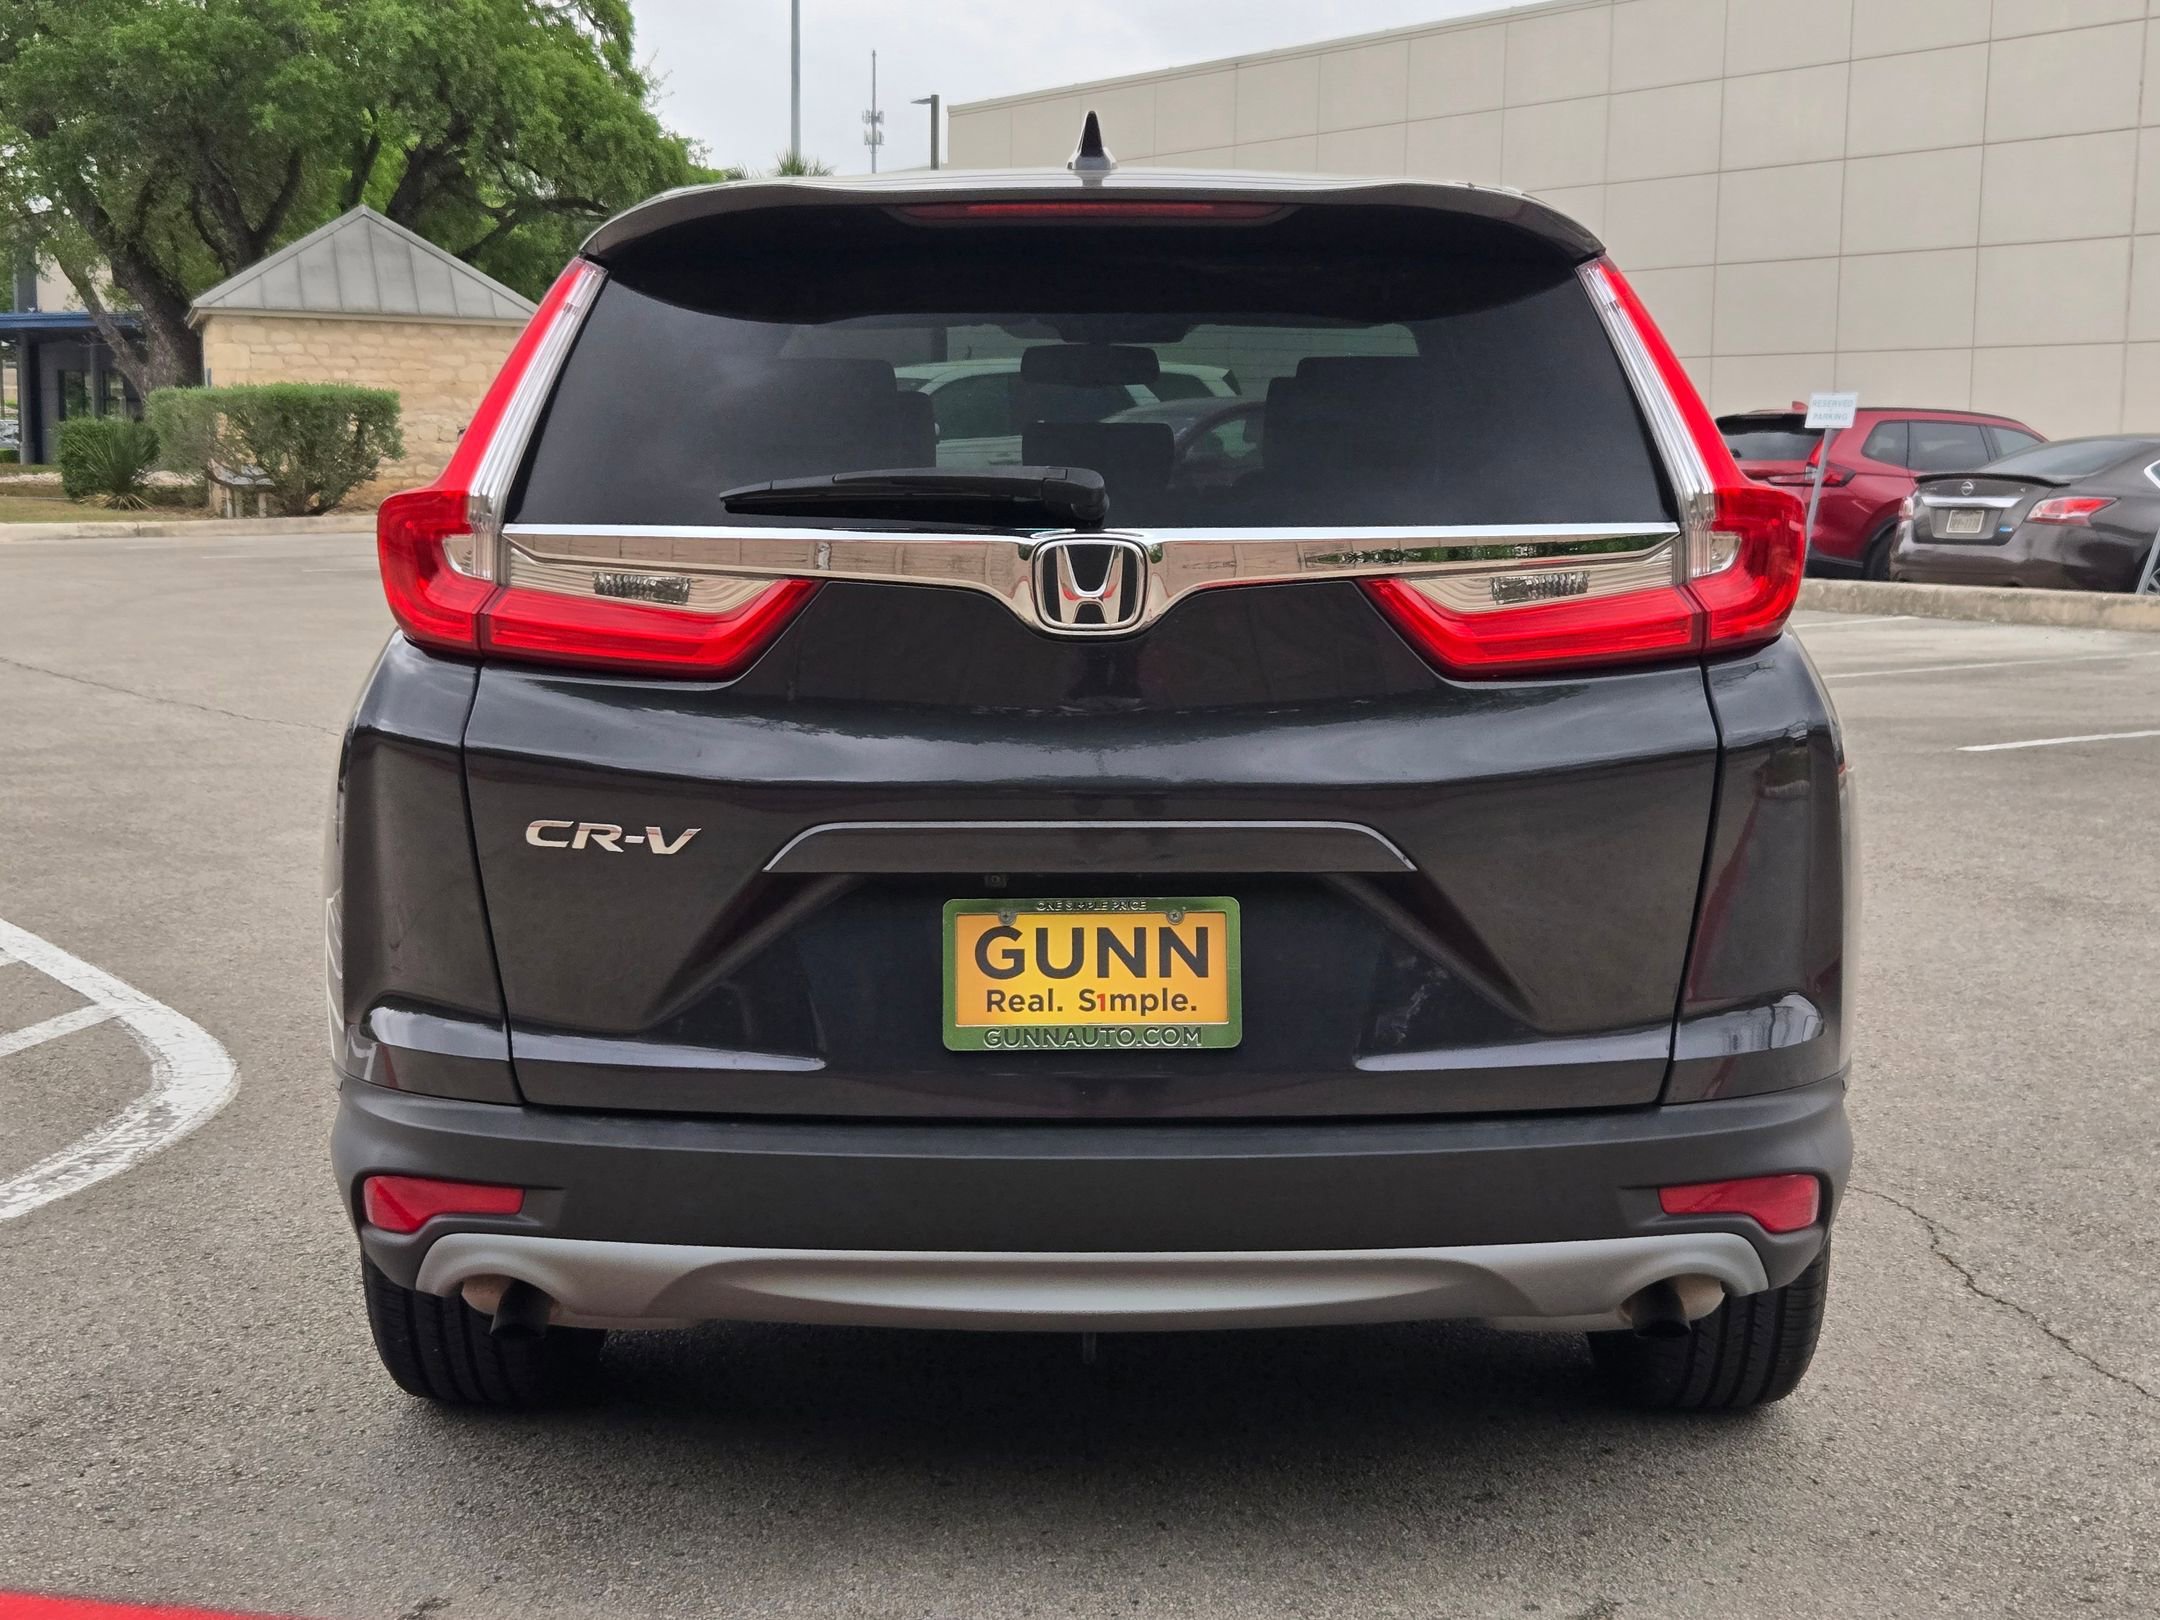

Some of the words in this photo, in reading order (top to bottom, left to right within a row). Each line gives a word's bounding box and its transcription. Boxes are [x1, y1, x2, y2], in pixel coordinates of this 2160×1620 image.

[1812, 399, 1854, 408] RESERVED
[1812, 412, 1849, 421] PARKING
[525, 819, 702, 855] CR-V
[1036, 900, 1063, 911] ONE
[1065, 900, 1109, 911] SIMPLE
[1111, 900, 1148, 911] PRICE
[974, 925, 1210, 980] GUNN
[985, 988, 1064, 1013] Real.
[983, 1026, 1203, 1049] GUNNAUTO.COM
